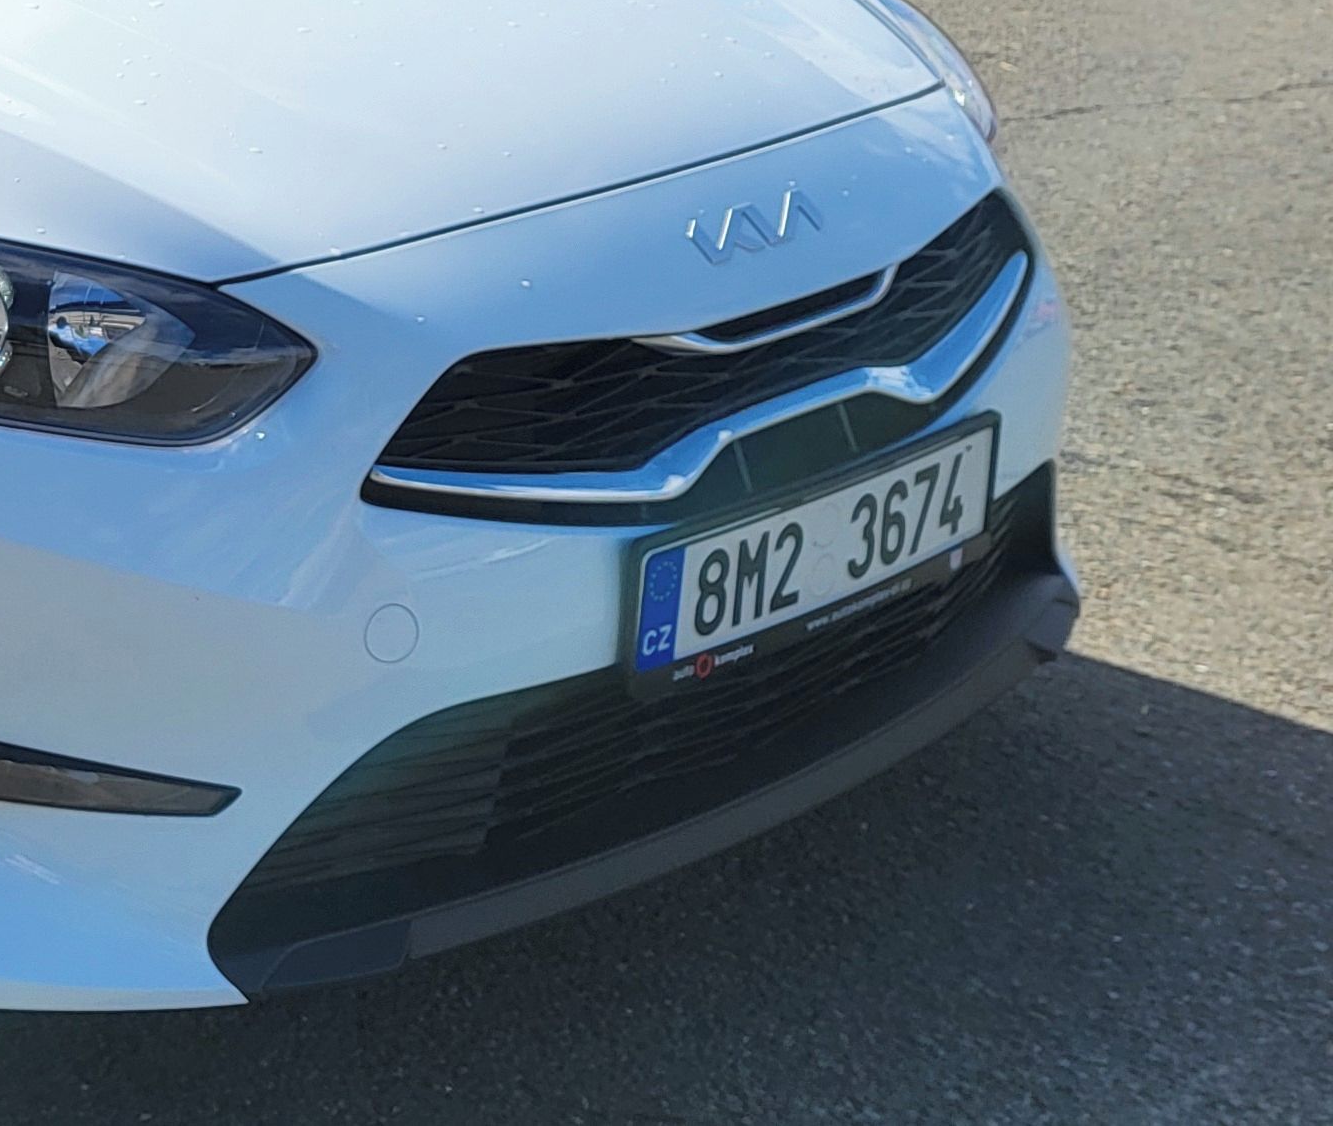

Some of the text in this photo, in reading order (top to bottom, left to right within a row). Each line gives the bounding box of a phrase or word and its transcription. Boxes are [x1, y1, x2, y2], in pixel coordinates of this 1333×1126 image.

[694, 521, 804, 636] 8M2
[847, 452, 964, 580] 3674
[641, 624, 673, 656] CZ
